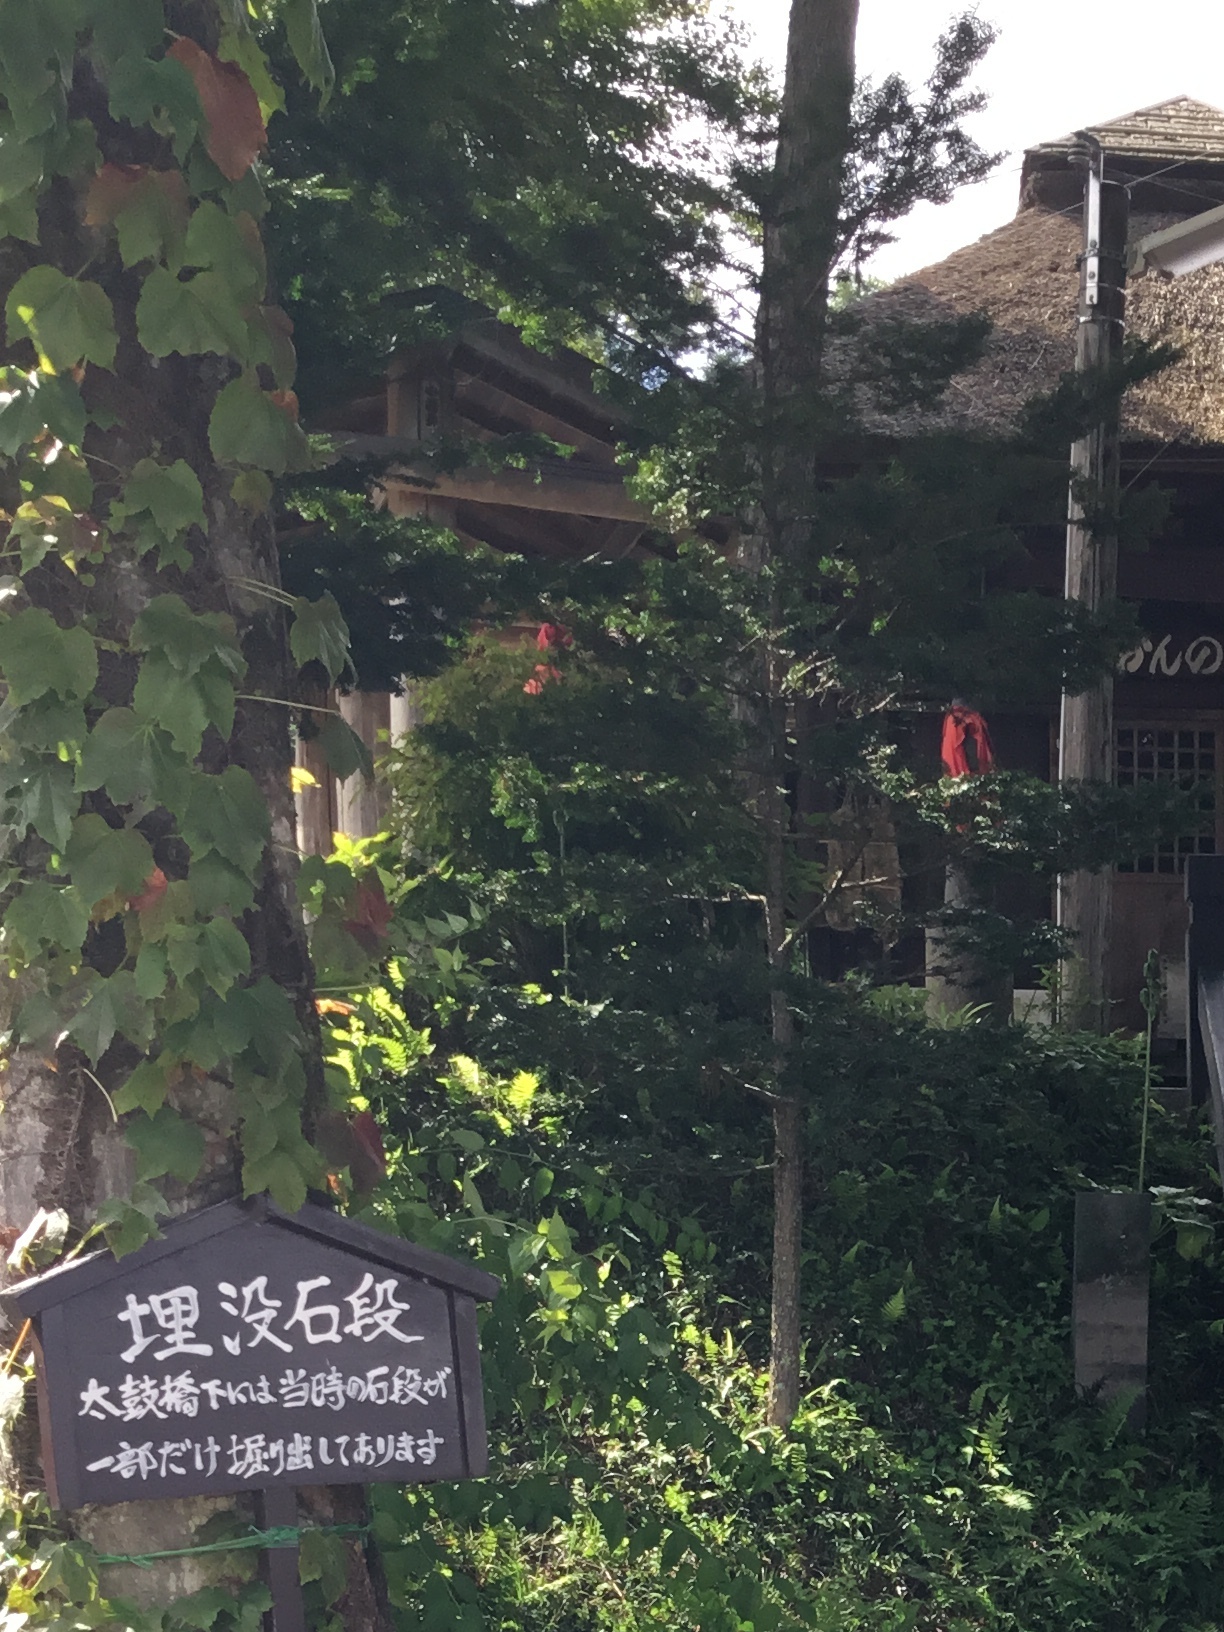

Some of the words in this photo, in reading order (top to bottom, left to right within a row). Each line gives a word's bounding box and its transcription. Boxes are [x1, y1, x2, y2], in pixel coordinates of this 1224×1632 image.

[118, 1272, 425, 1364] 埋没石段
[77, 1366, 453, 1422] 太鼓橋下には当時の石段が
